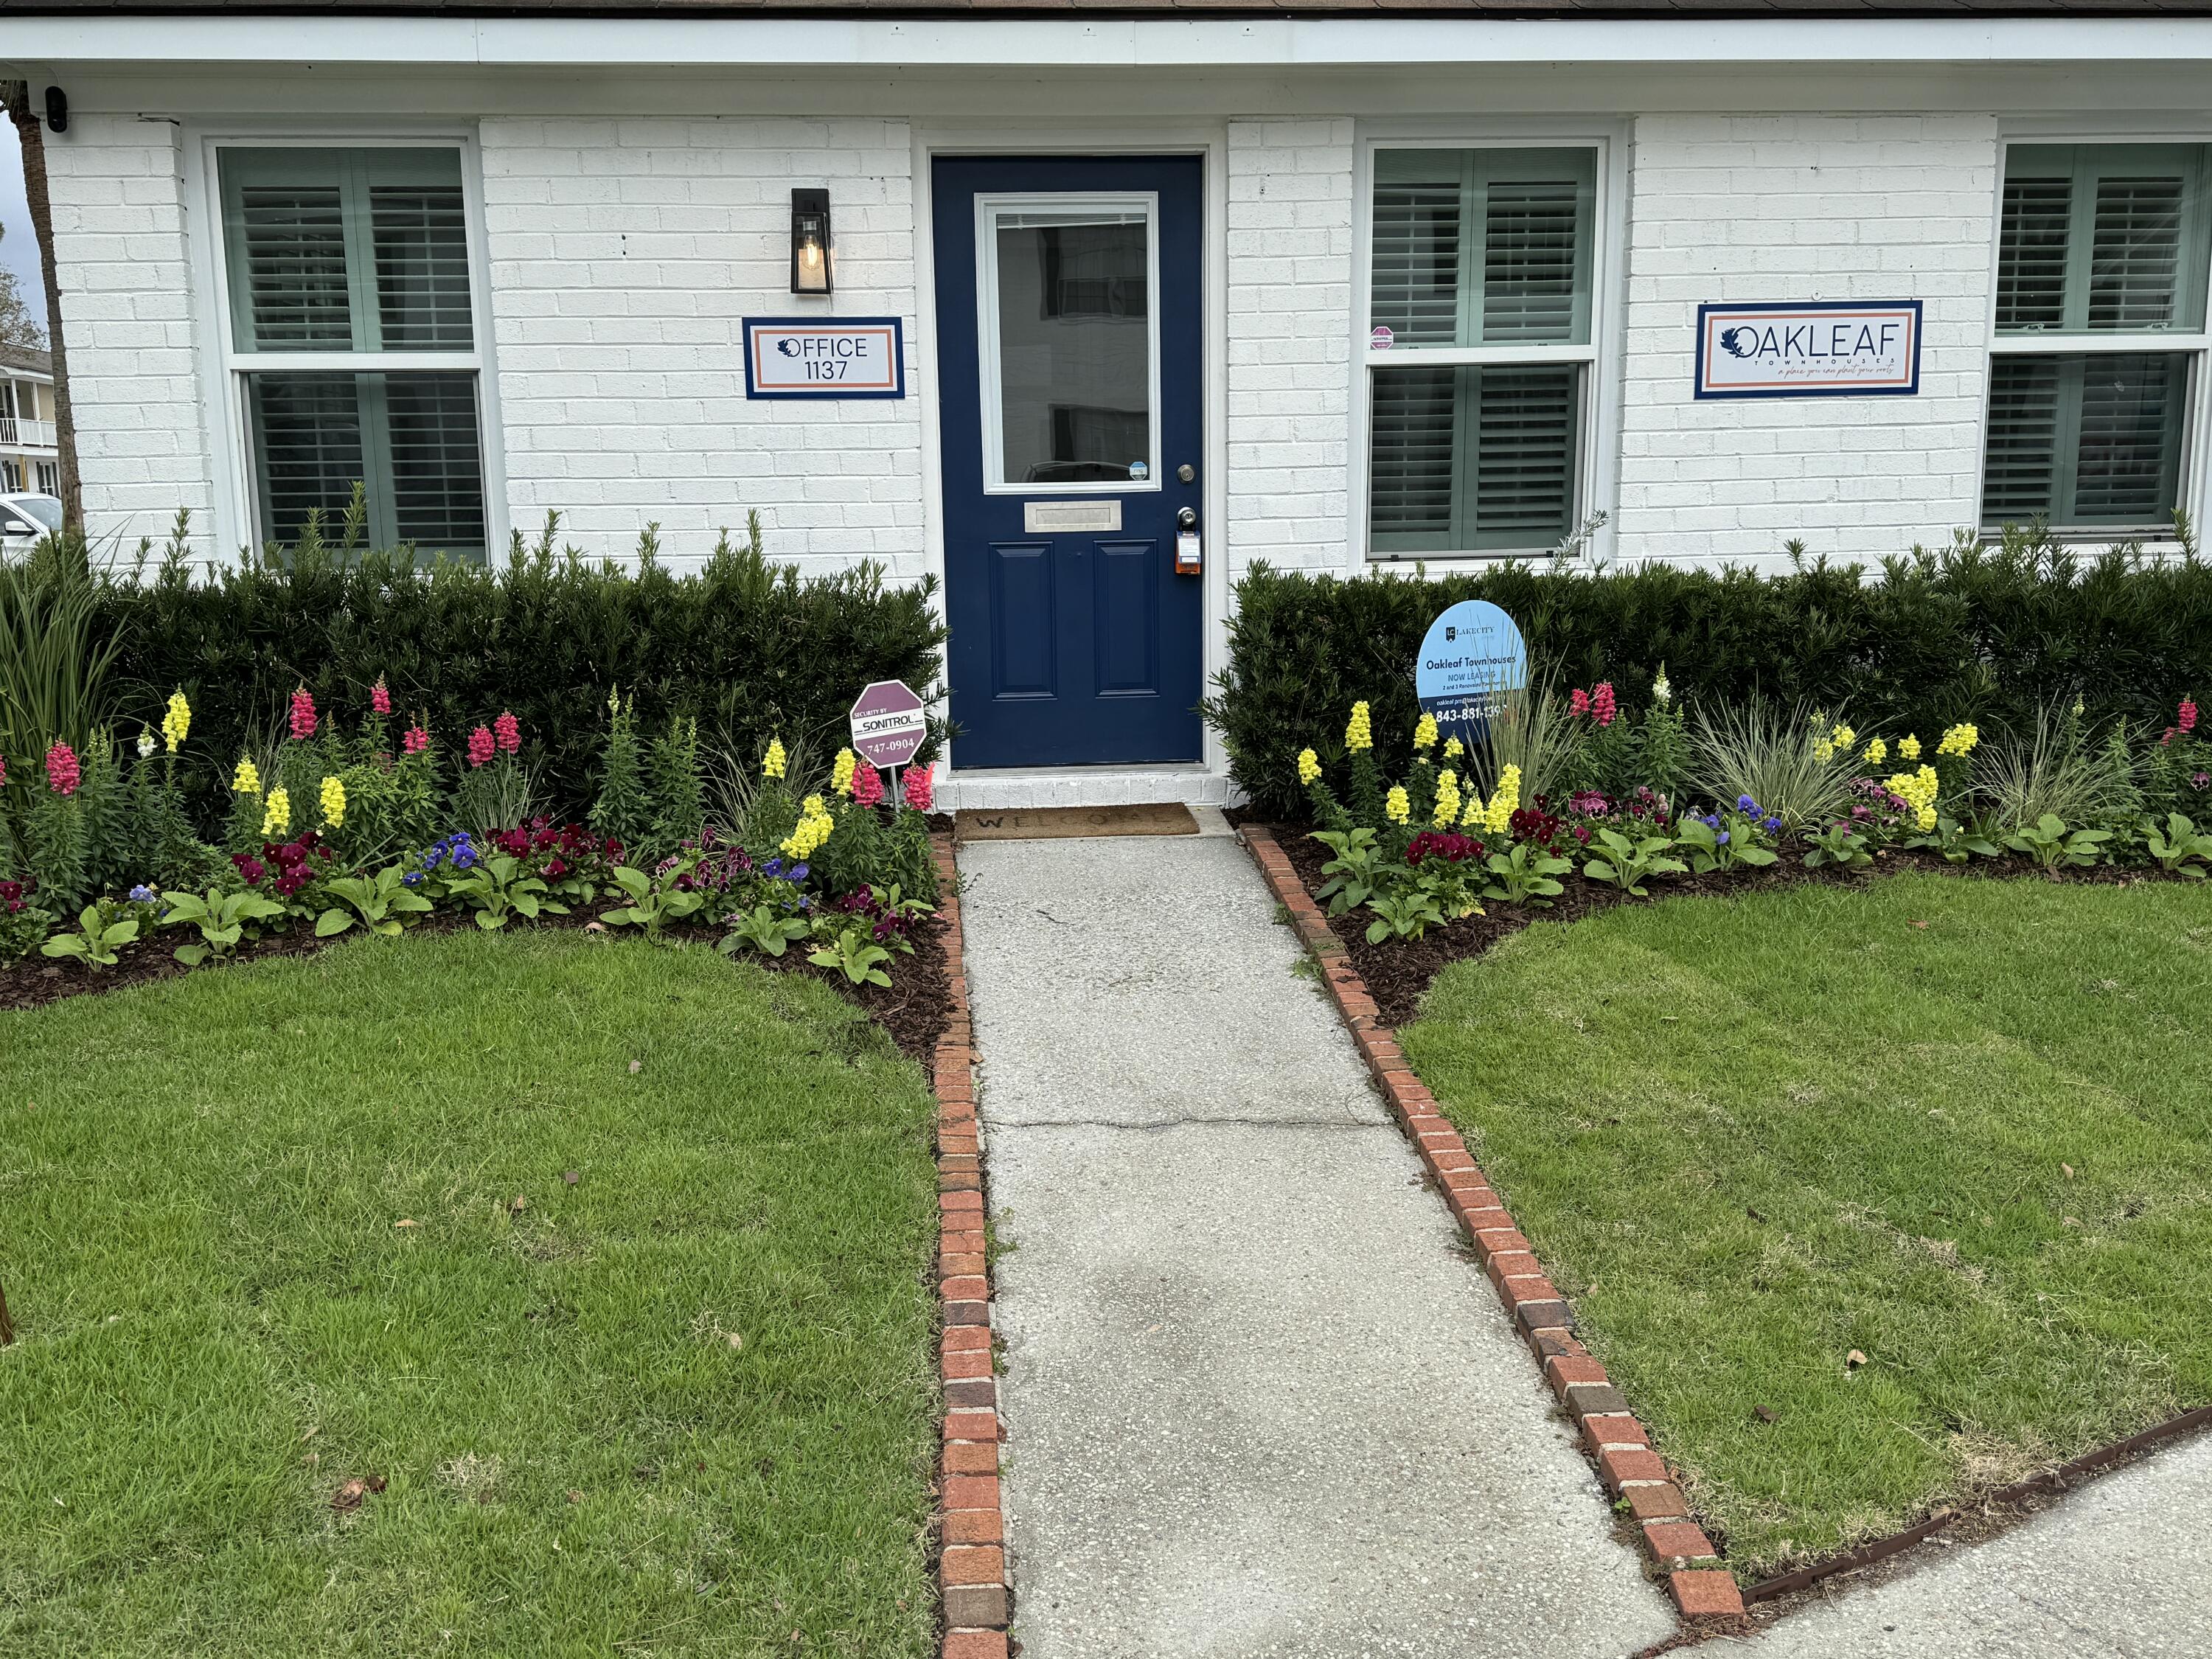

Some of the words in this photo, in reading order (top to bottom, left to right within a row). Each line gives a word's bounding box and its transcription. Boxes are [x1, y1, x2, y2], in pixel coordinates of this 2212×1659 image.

[784, 338, 868, 358] OFFICE
[1731, 323, 1899, 358] OAKLEAF
[1754, 358, 1895, 366] TOWNHOUSES
[804, 361, 848, 380] 1137
[1784, 366, 1806, 379] place
[1806, 369, 1821, 378] you
[1836, 364, 1860, 378] plant
[1857, 367, 1874, 376] your
[1426, 657, 1463, 670] Oakleaf
[1464, 655, 1516, 667] Townhouses
[1447, 673, 1466, 682] NOW
[1467, 671, 1496, 680] LEASING
[854, 709, 880, 718] SECURITY
[863, 715, 914, 731] SONITROL
[867, 738, 914, 755] 747-0904
